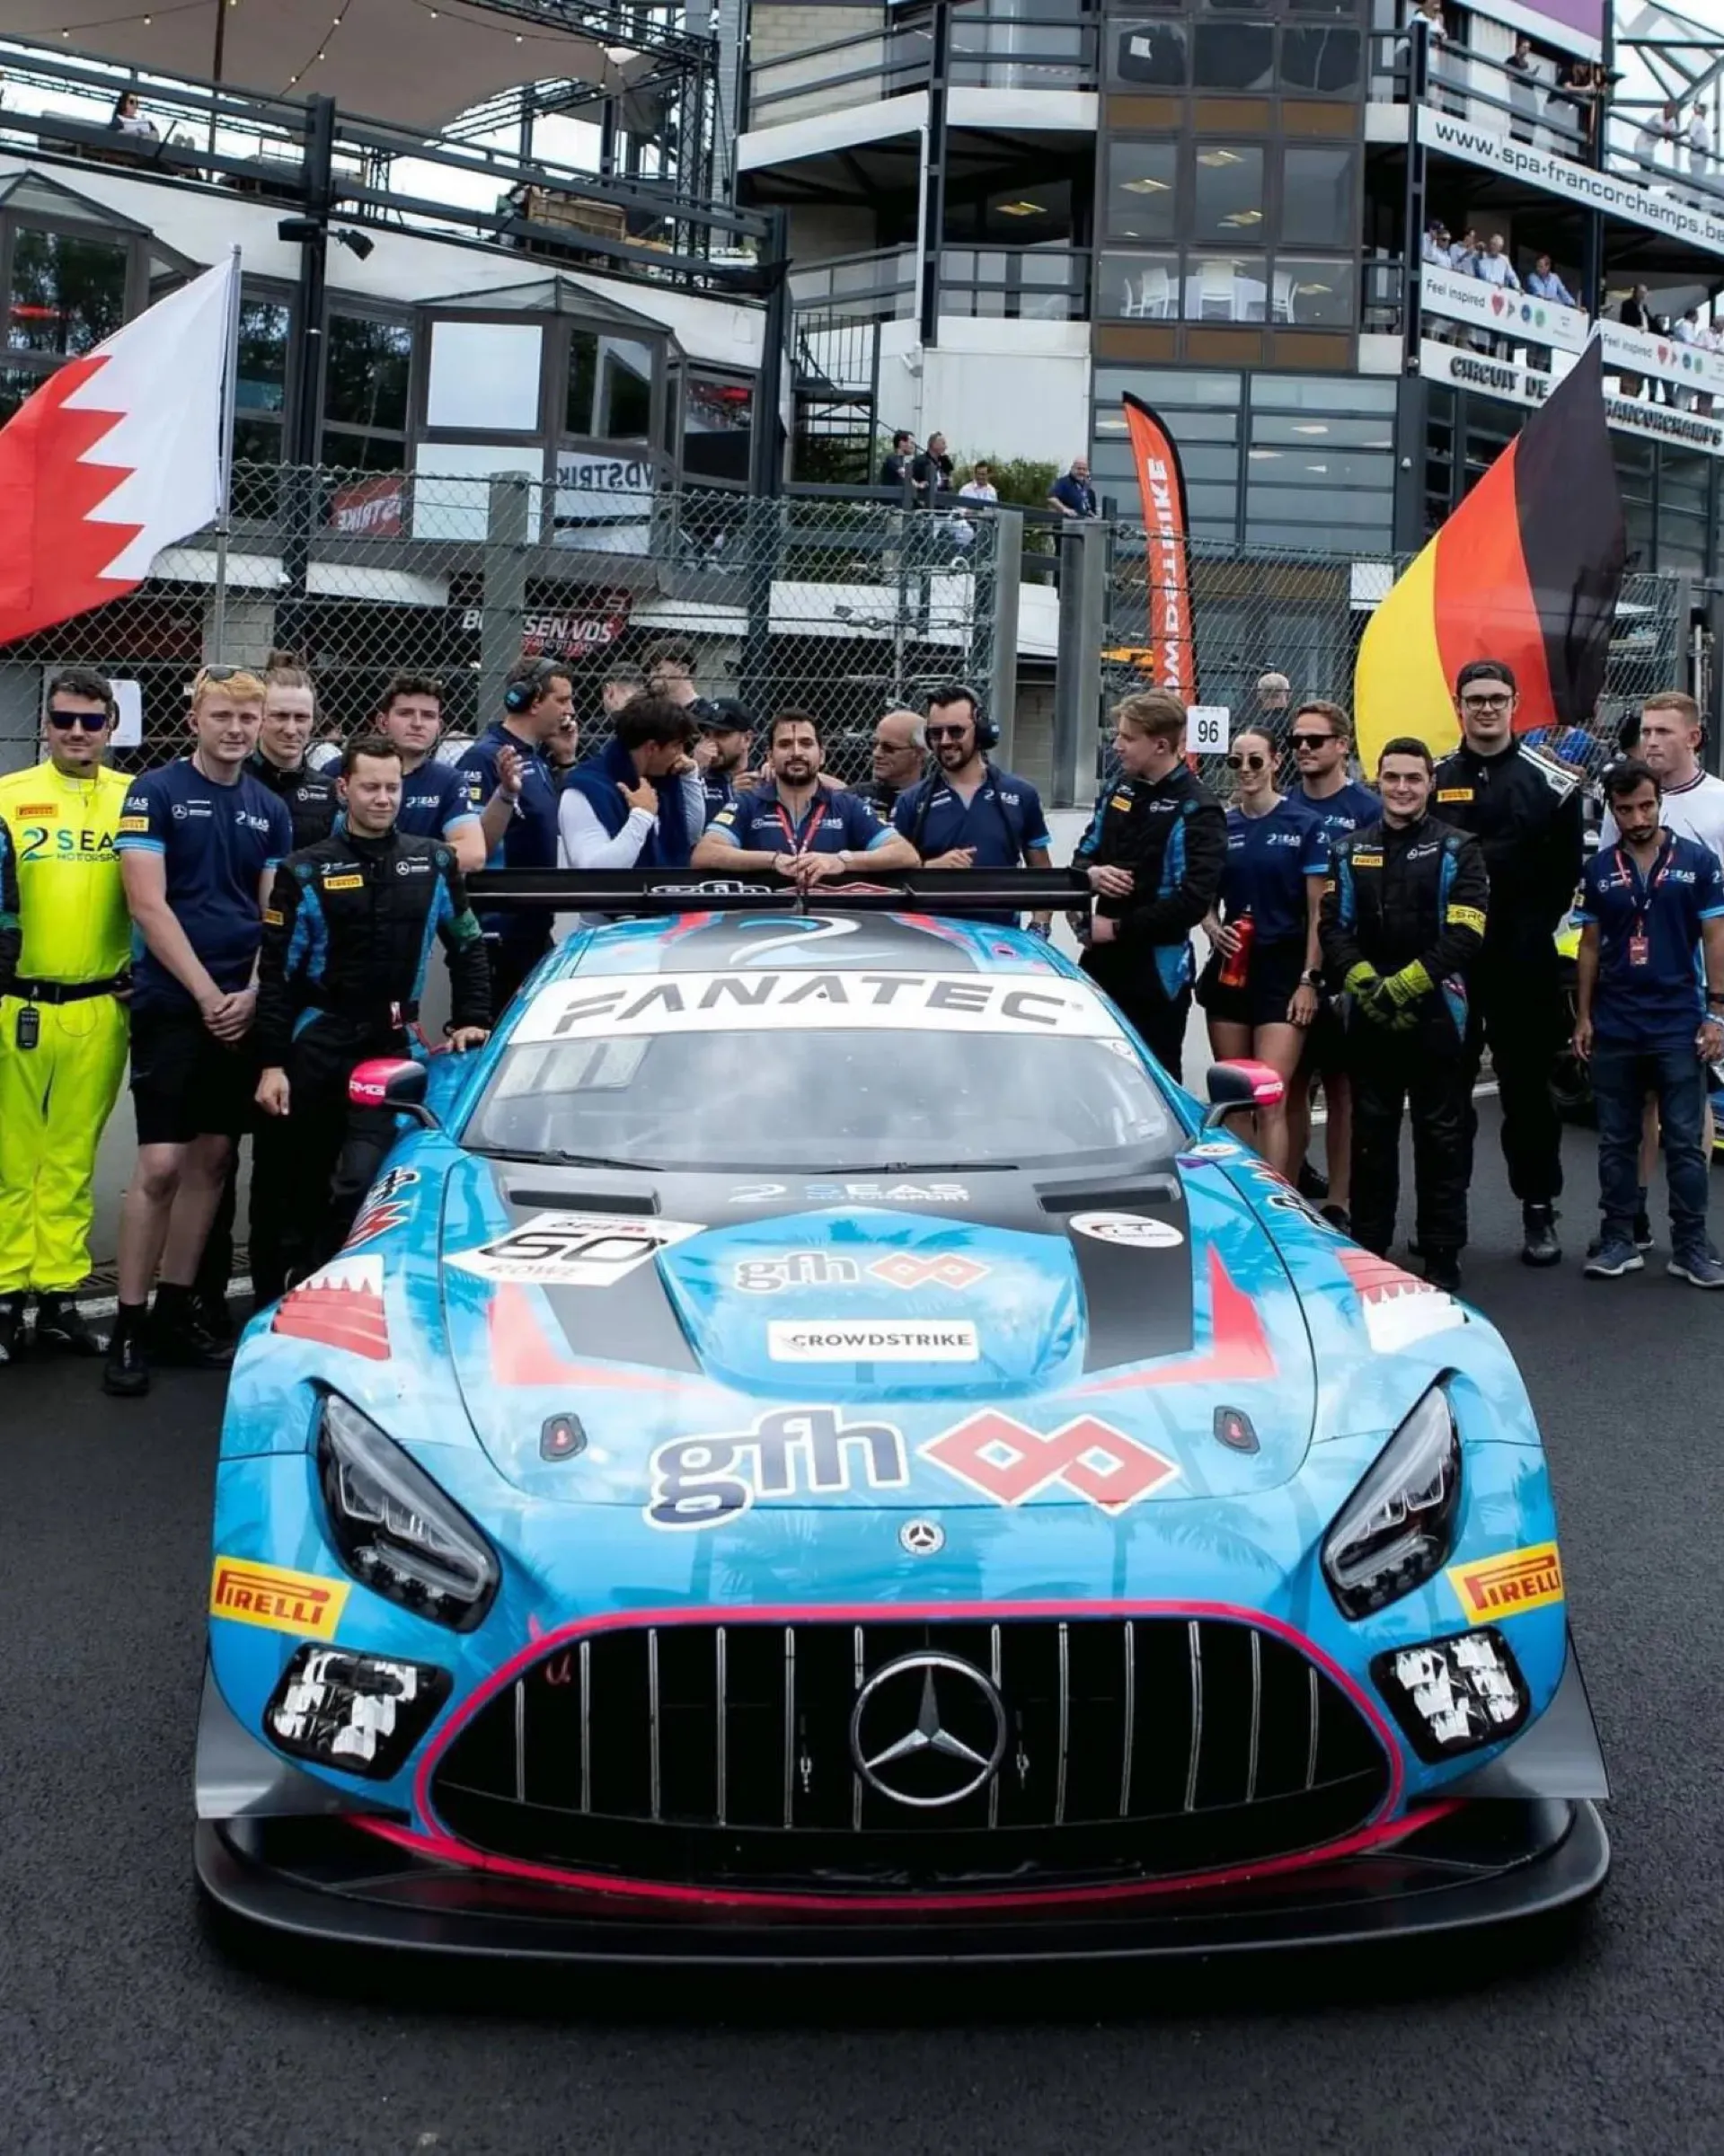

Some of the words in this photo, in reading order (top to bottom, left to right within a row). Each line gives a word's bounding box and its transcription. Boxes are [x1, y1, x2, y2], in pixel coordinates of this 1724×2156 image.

[1427, 279, 1446, 295] Feel
[1449, 289, 1485, 308] inspired
[1450, 355, 1519, 391] CIRCUIT
[1525, 375, 1549, 399] DE
[1198, 720, 1219, 743] 96
[57, 828, 115, 852] SEA
[57, 853, 121, 862] MOTORSPO
[553, 975, 1066, 1035] FANATEC
[805, 1183, 969, 1196] SEAS
[806, 1193, 970, 1202] MOTORSPORT
[734, 1250, 859, 1294] gfh
[791, 1333, 972, 1348] CROWDSTRIKE
[641, 1407, 909, 1531] gfh
[215, 1569, 331, 1625] PIRELLI
